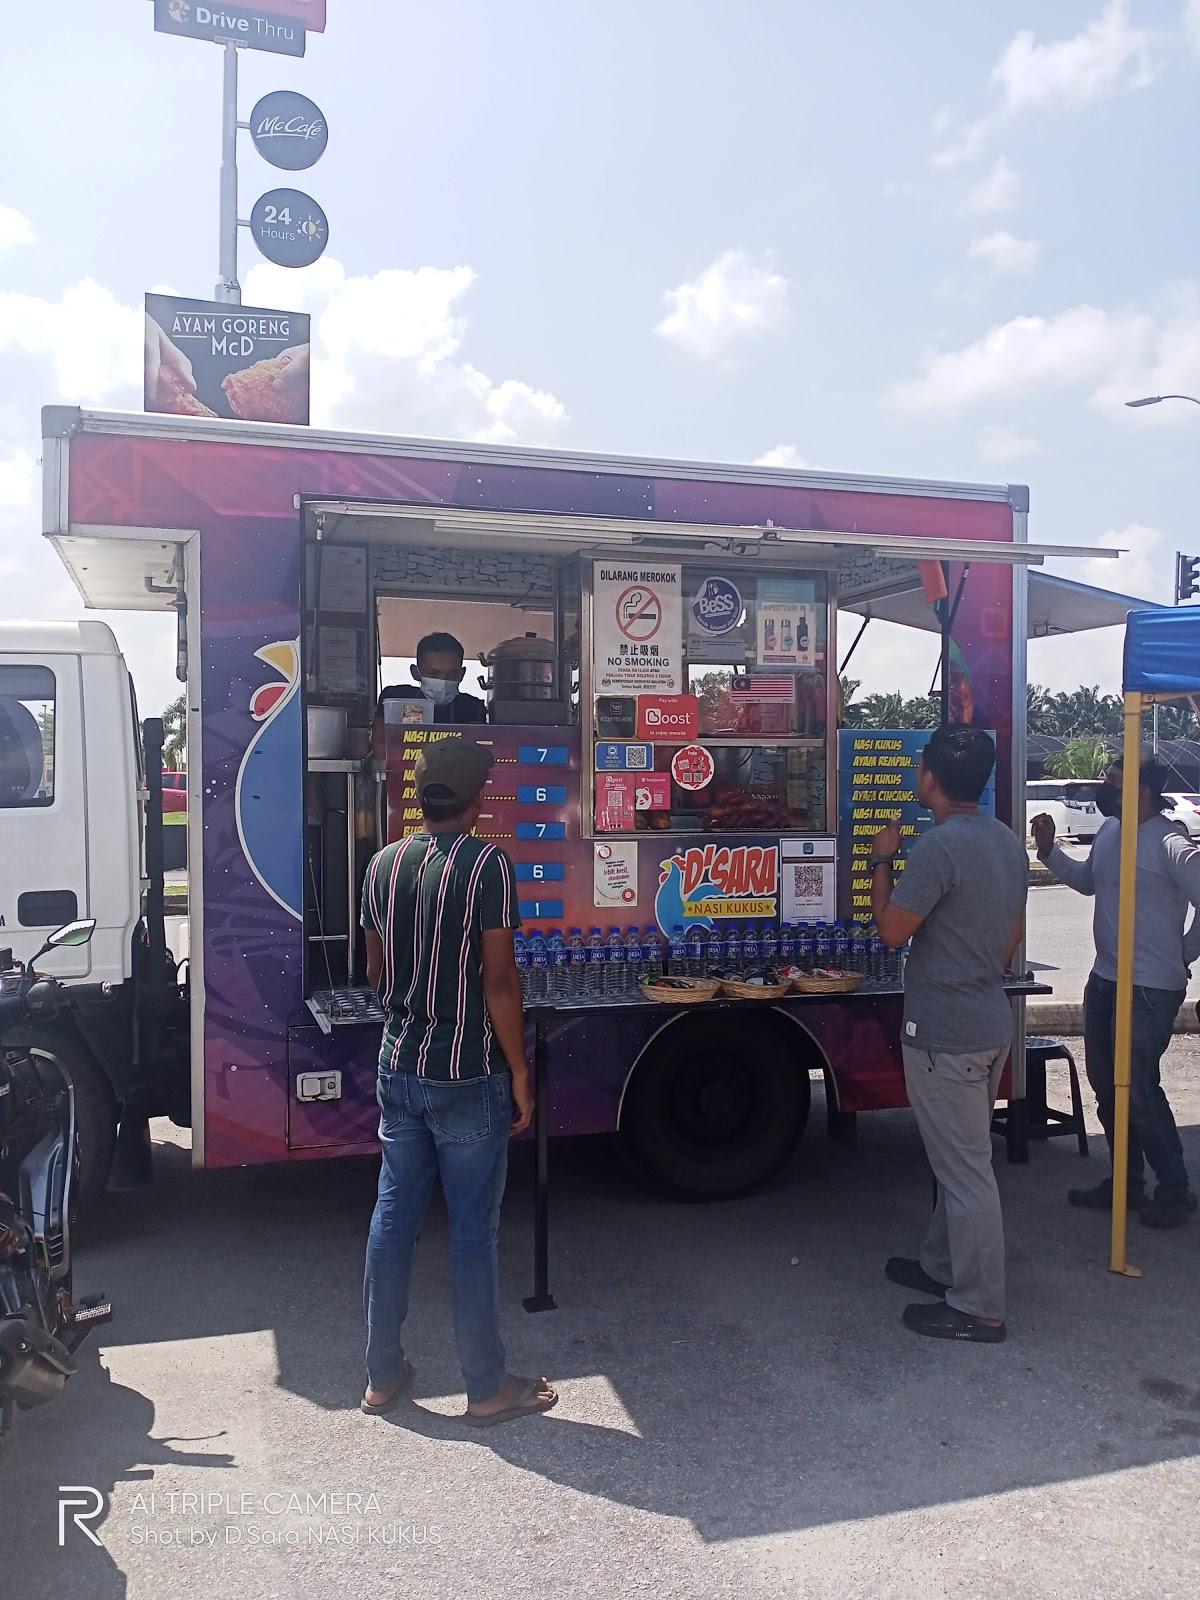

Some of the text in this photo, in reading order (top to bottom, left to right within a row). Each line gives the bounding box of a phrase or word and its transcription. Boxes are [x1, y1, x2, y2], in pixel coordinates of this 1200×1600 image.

[196, 7, 294, 40] Drive Thru
[257, 115, 323, 139] McCafé
[264, 205, 292, 225] 24
[261, 226, 296, 241] Hours
[172, 317, 290, 335] AYAM GORENG
[600, 570, 676, 583] DILARANG MEROKOK
[700, 594, 734, 614] BeSS
[619, 644, 659, 657] 禁止吸烟
[607, 657, 670, 667] NO SMOKING
[646, 708, 691, 725] Boost
[403, 731, 428, 742] NASI
[854, 739, 902, 750] NASI KUKUS
[402, 748, 422, 760] AYA
[537, 749, 548, 762] 7
[852, 755, 876, 767] AYAM
[852, 774, 902, 785] NASI KUKUS
[536, 788, 546, 802] 6
[852, 790, 876, 801] AYAM
[403, 808, 424, 820] NAS
[852, 808, 902, 819] NASI KUKUS
[535, 824, 546, 838] 7
[533, 865, 543, 878] 6
[683, 844, 778, 896] D'SARA
[852, 879, 873, 890] NASI
[535, 903, 540, 916] 1
[694, 901, 764, 915] NASI KUKUS
